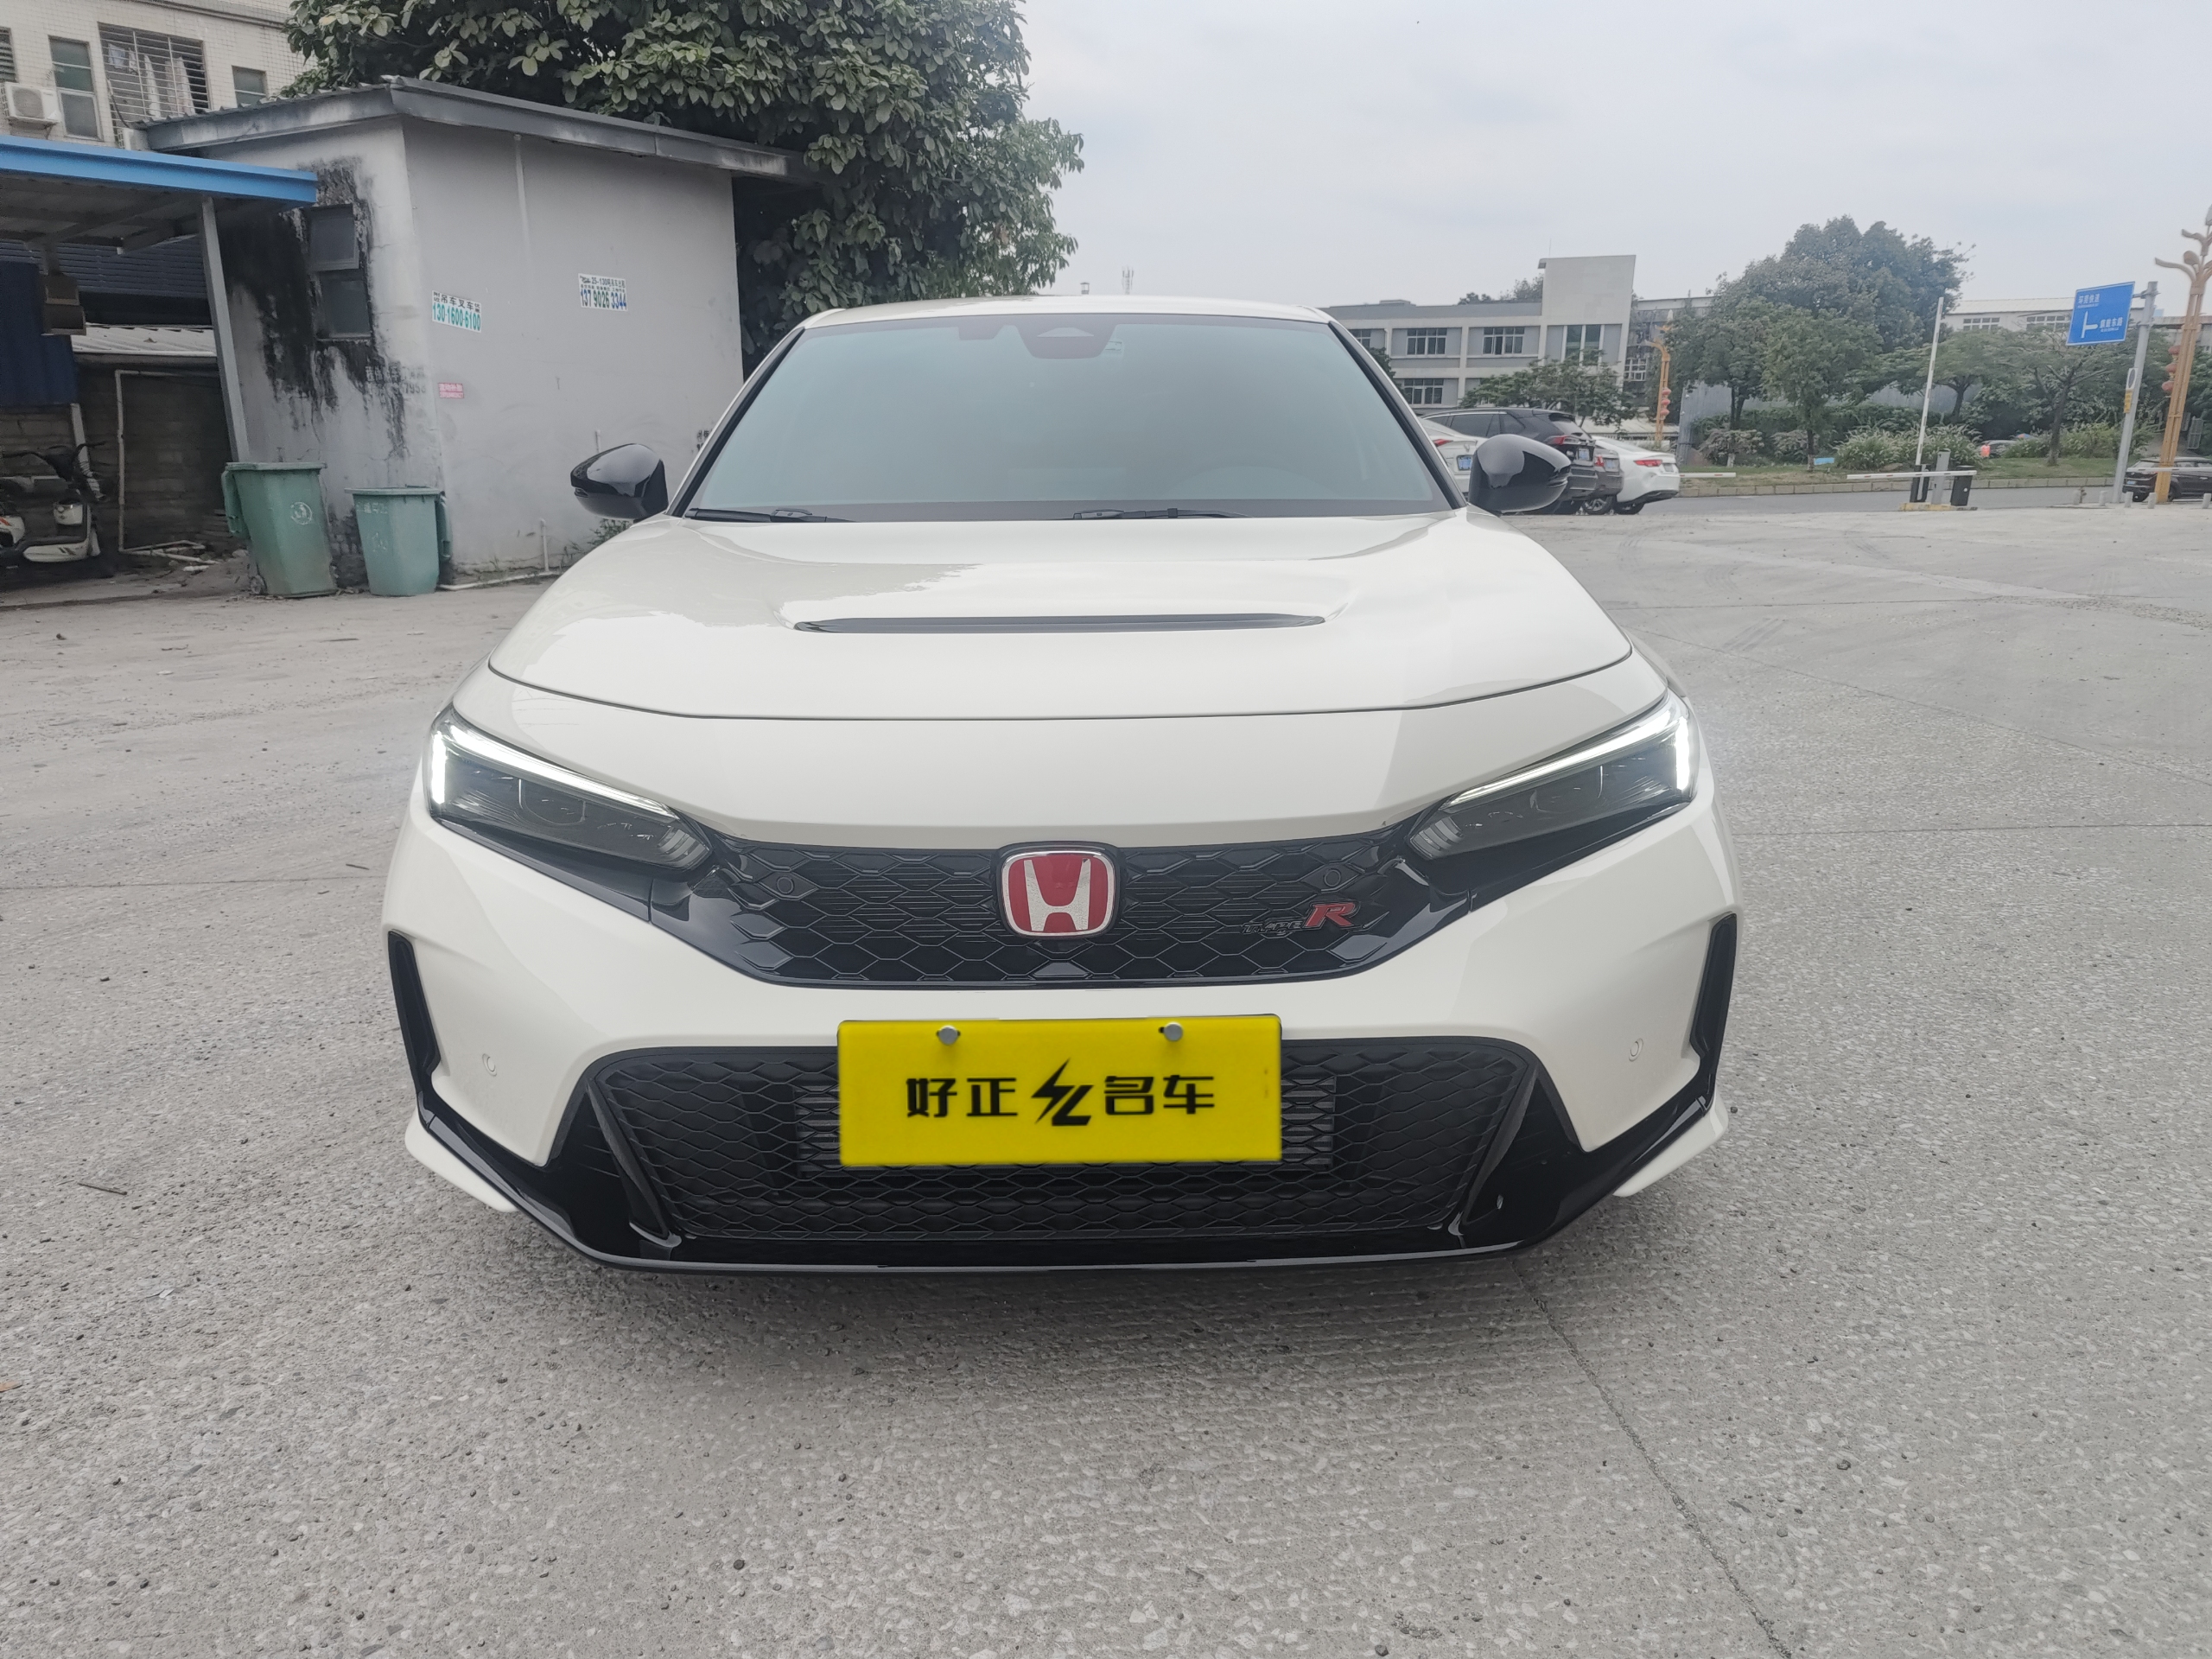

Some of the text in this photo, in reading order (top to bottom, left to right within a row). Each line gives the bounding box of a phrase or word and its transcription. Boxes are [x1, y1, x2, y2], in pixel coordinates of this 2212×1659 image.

[581, 289, 592, 307] 137
[593, 289, 610, 308] 9026
[611, 291, 626, 310] 3344
[432, 302, 481, 331] 130-1600-6100
[1305, 901, 1357, 928] R
[906, 1074, 1215, 1117] 好正 名车
